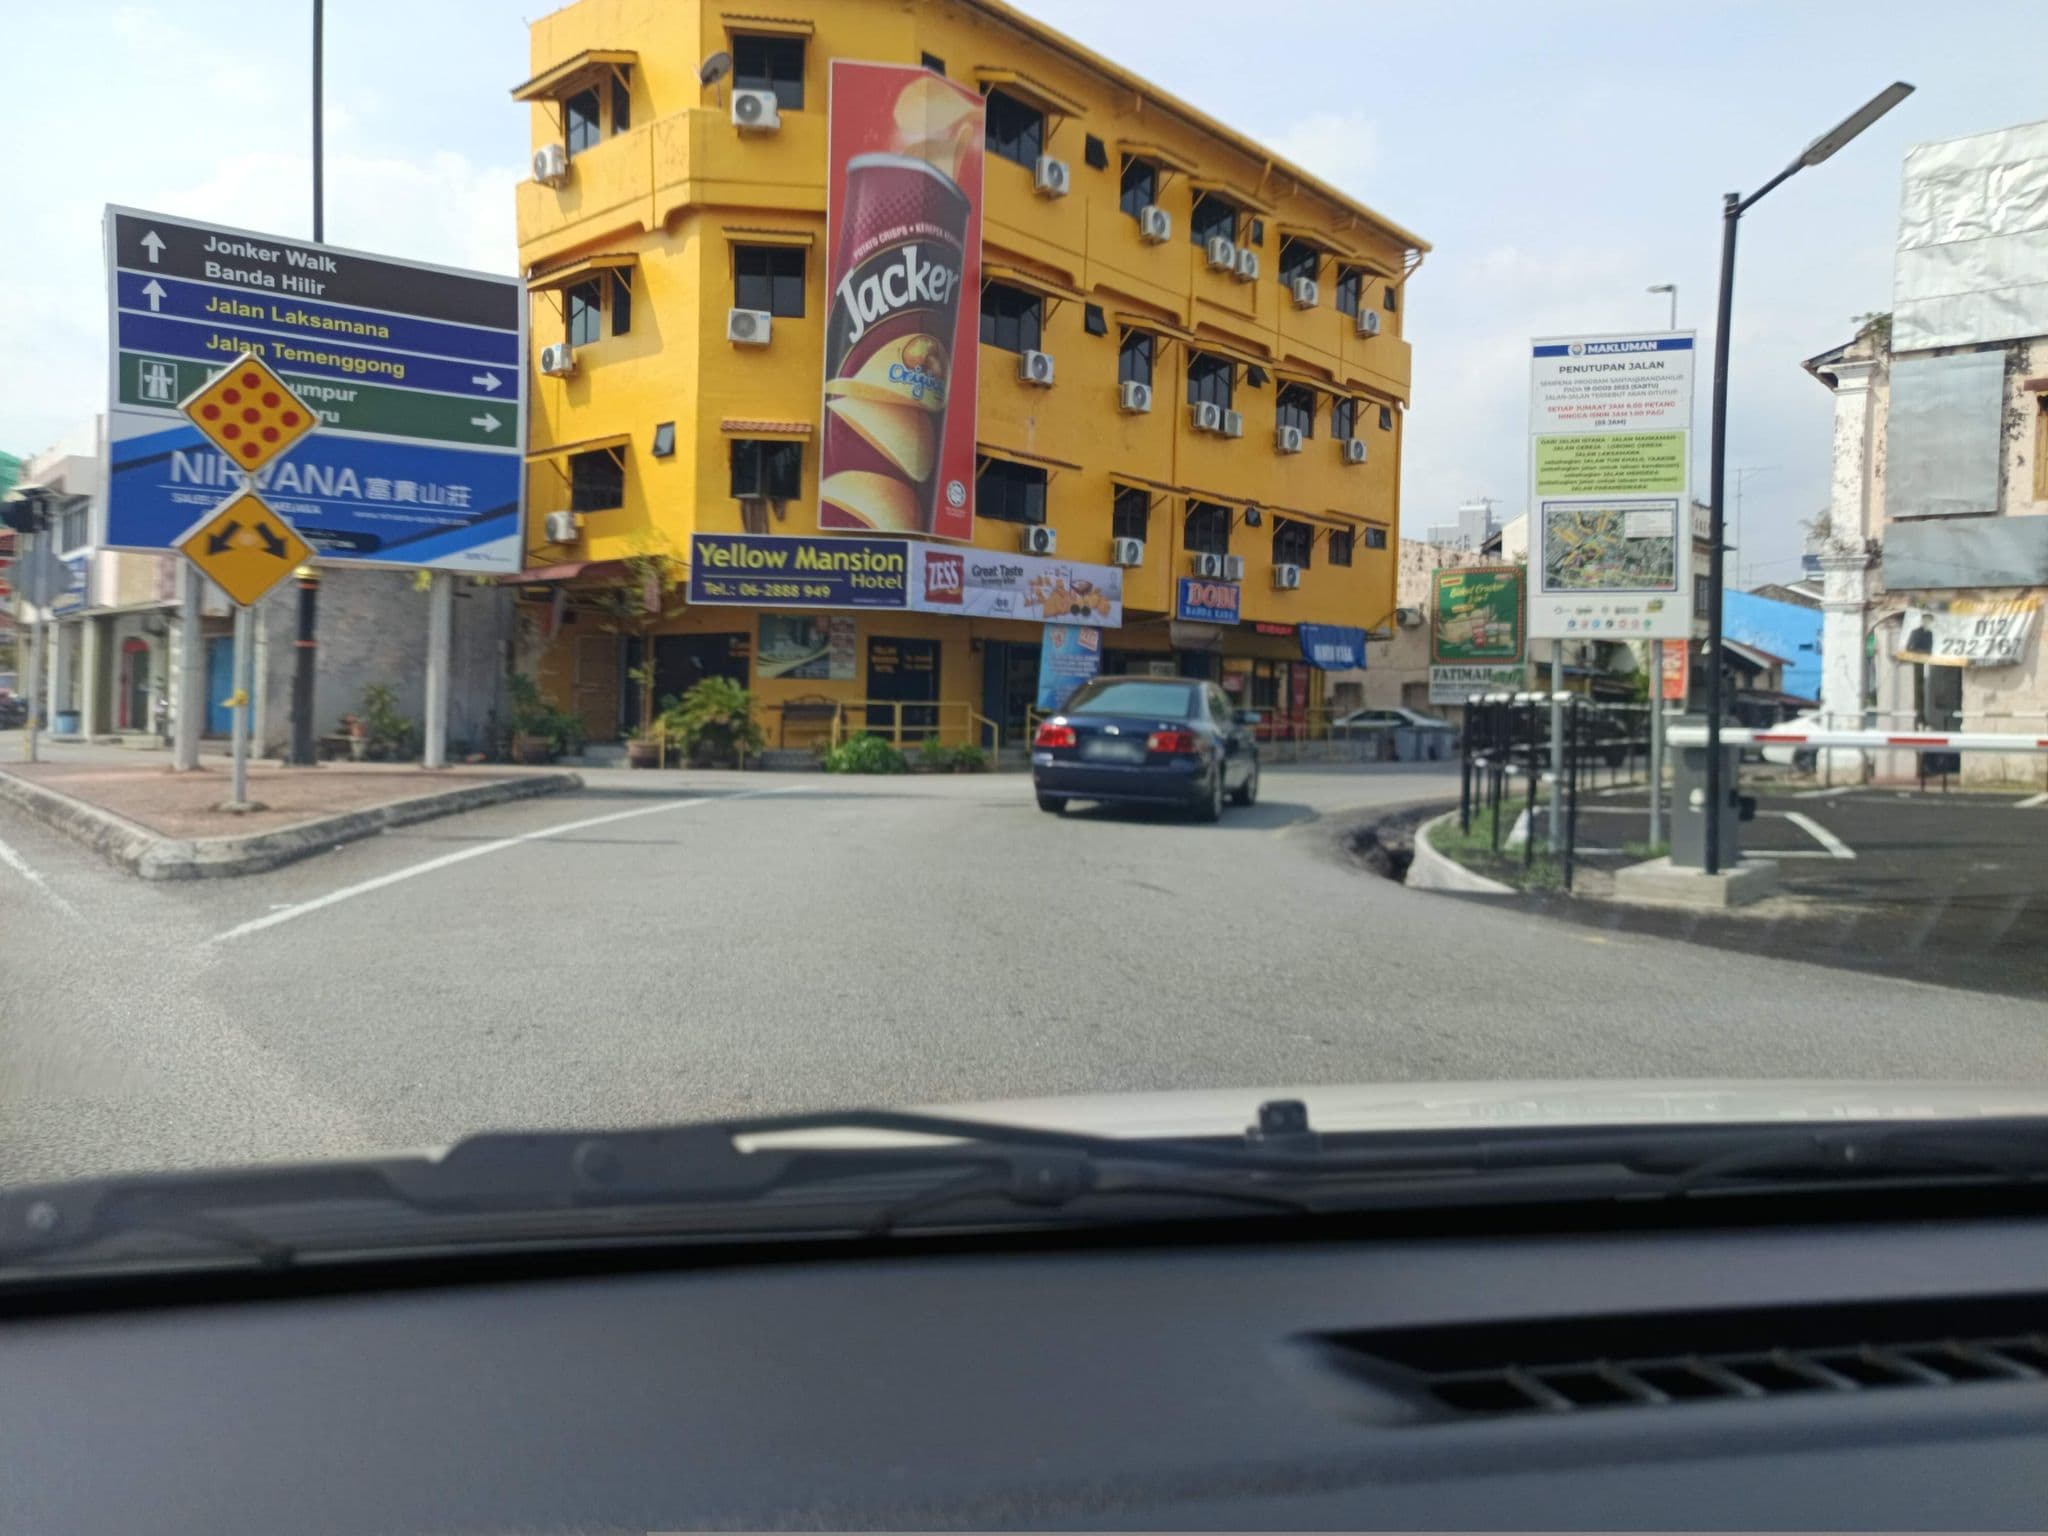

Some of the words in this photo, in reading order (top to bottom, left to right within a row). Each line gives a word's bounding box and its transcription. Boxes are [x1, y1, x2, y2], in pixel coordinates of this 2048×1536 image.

[879, 225, 908, 243] CRISPS
[204, 236, 281, 263] Jonker
[285, 249, 337, 273] Walk
[205, 261, 276, 288] Banda
[282, 273, 327, 296] Hilir
[836, 245, 959, 344] Jacker
[206, 296, 265, 319] Jalan
[271, 305, 390, 339] Laksamana
[206, 334, 265, 357] Jalan
[272, 342, 406, 379] Temenggong
[1587, 341, 1658, 355] MAKLUMAN
[1559, 362, 1626, 374] PENUTUPAN
[1629, 360, 1665, 371] JALAN
[288, 382, 358, 403] umpur
[170, 449, 361, 499] NIRVANA
[697, 542, 788, 569] Yellow
[794, 546, 904, 572] Mansion
[851, 572, 904, 590] Hotel
[928, 559, 960, 592] ZESS
[971, 564, 998, 577] Great
[1000, 564, 1024, 577] Taste
[703, 581, 737, 597] Tel.:
[739, 583, 800, 598] 06-2888
[802, 584, 831, 599] 949
[1433, 667, 1492, 682] FATIMAH
